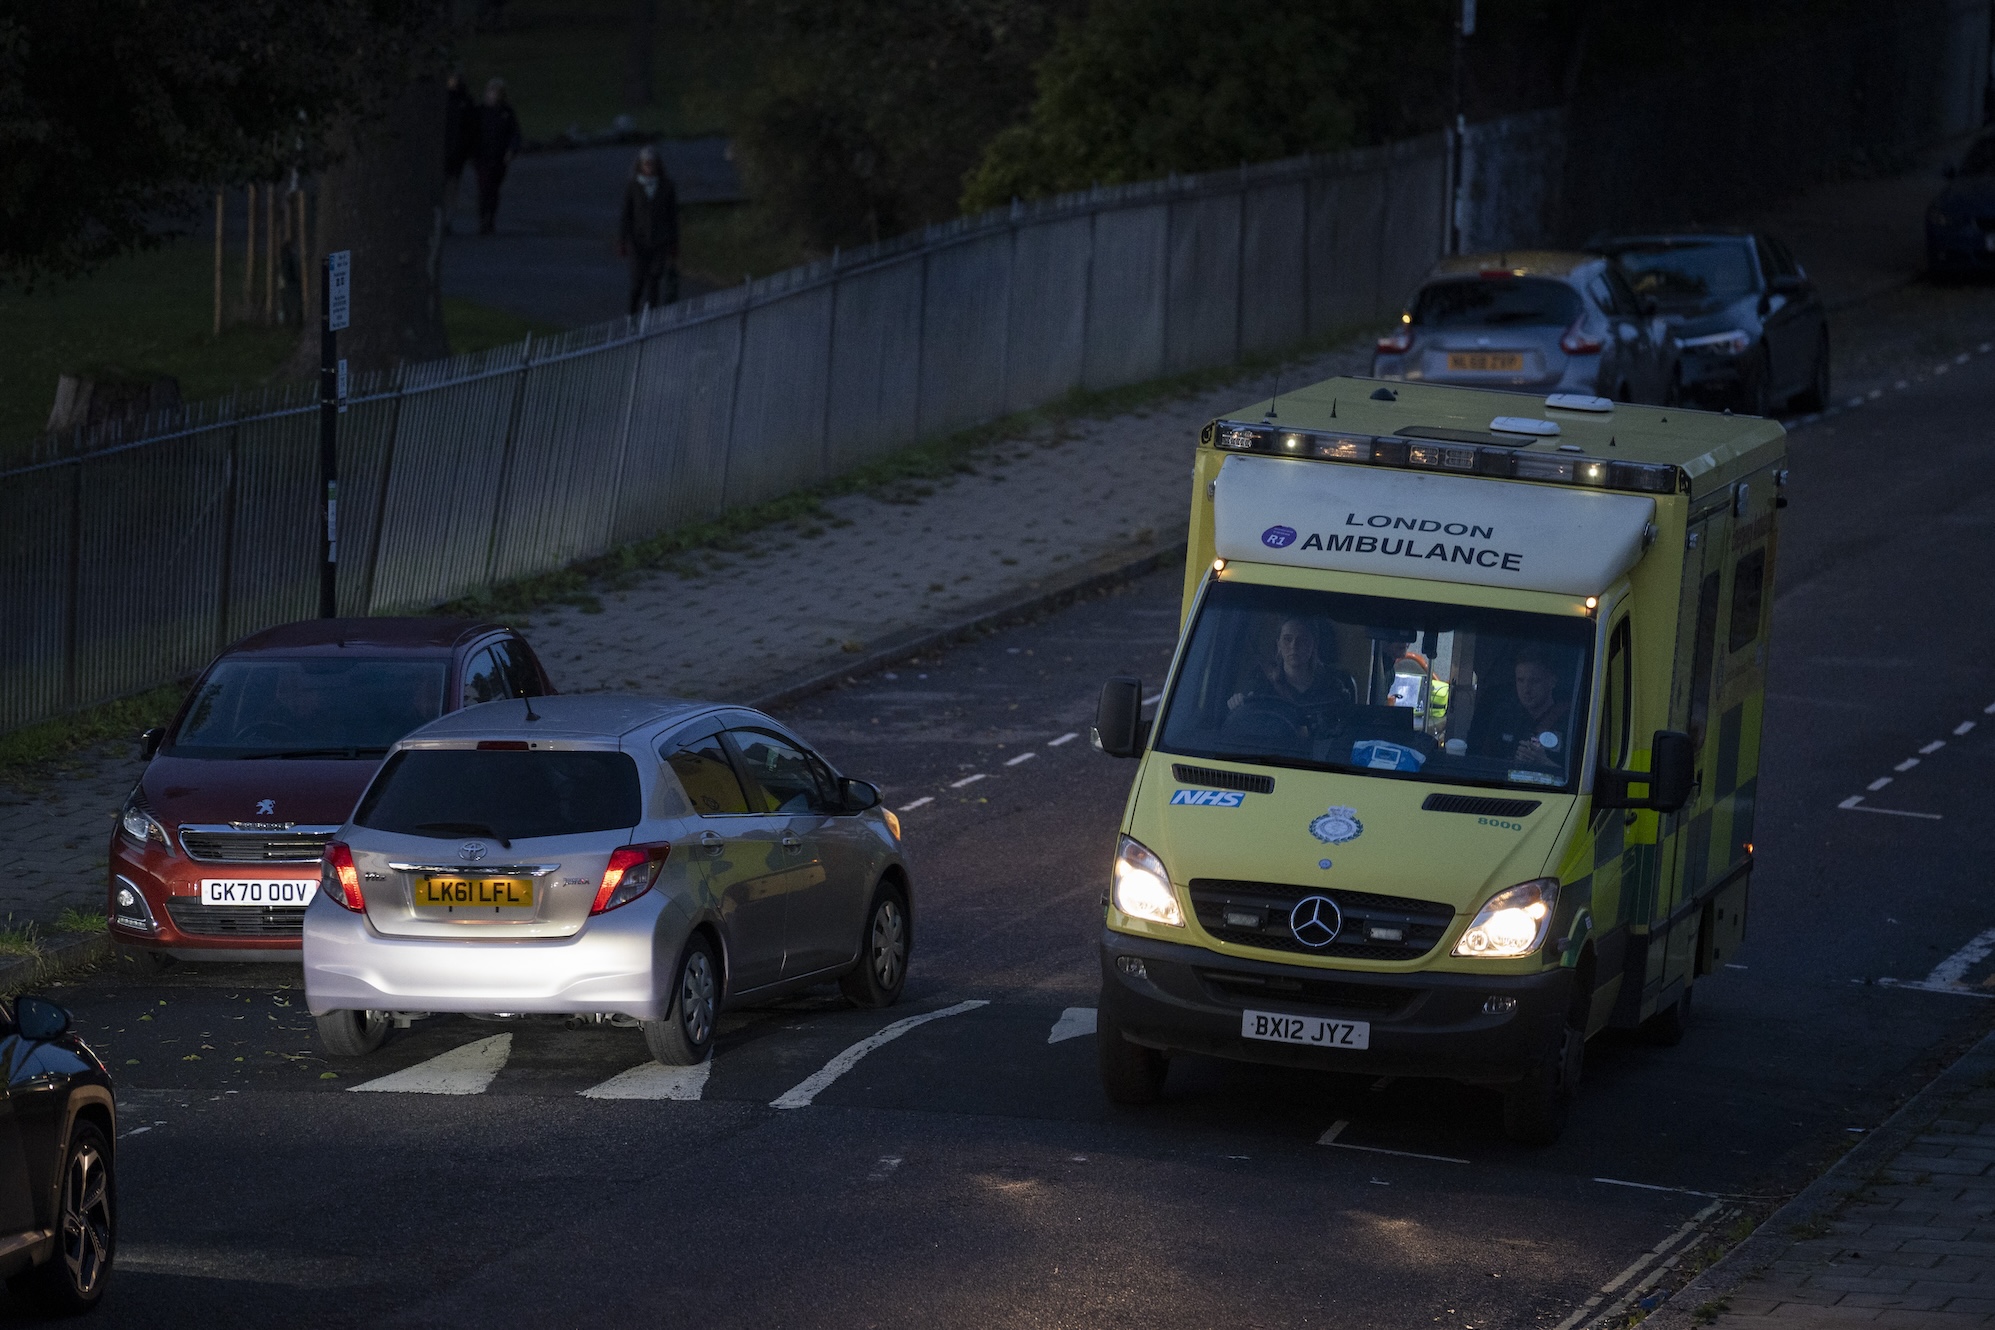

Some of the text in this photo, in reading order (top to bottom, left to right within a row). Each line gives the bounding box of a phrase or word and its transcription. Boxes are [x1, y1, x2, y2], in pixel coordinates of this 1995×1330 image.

[1345, 513, 1494, 540] LONDON
[1266, 534, 1286, 546] R1
[1300, 533, 1524, 572] AMBULANCE
[1173, 790, 1244, 807] NHS
[1477, 817, 1522, 832] 8000
[211, 883, 307, 901] GK70 OOV
[427, 881, 520, 903] LK61 LFL
[1255, 1015, 1355, 1045] BX12 JYZ
